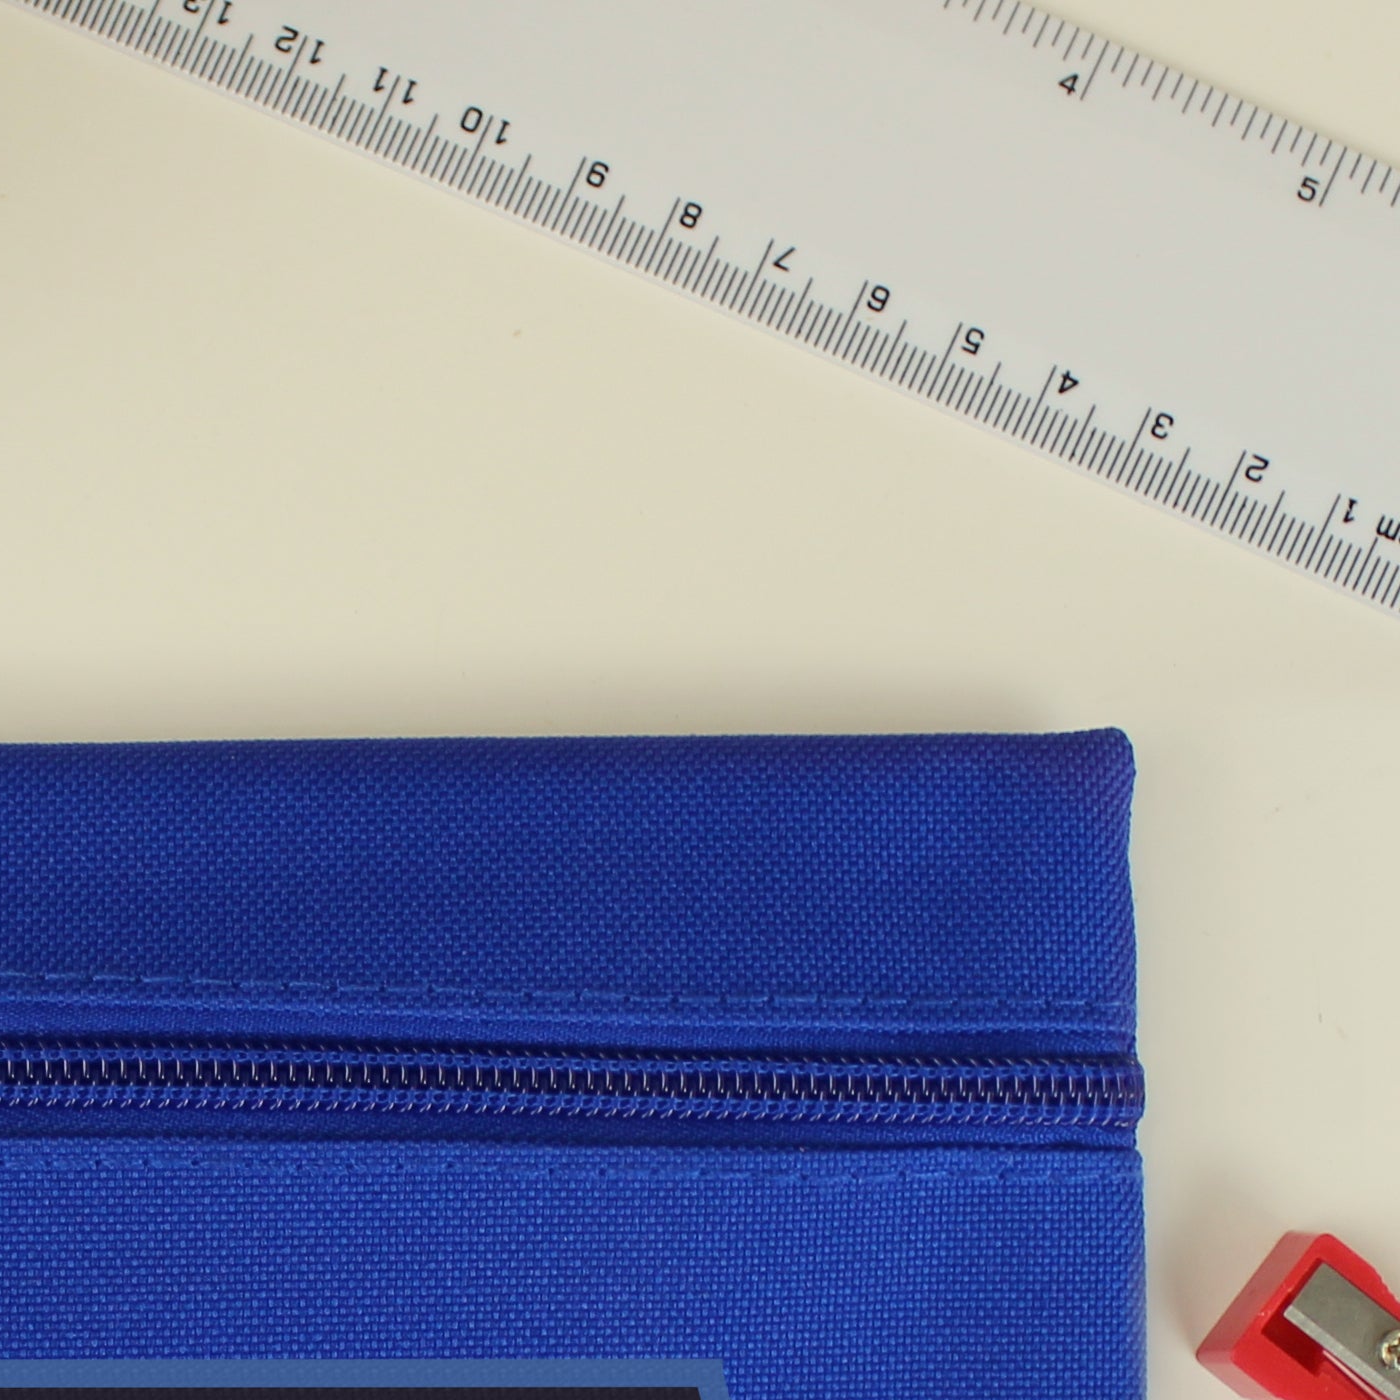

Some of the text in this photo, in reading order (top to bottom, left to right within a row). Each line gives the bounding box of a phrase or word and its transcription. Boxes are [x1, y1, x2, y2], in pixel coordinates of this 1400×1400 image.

[1058, 73, 1319, 202] 4 5
[586, 161, 610, 188] 9
[679, 202, 702, 229] 8
[772, 247, 796, 271] 7
[867, 285, 891, 312] 6
[961, 327, 985, 355] 5
[1057, 370, 1079, 395] 4
[1151, 413, 1174, 440] 3
[1245, 454, 1270, 482] 2
[1343, 498, 1358, 523] 1
